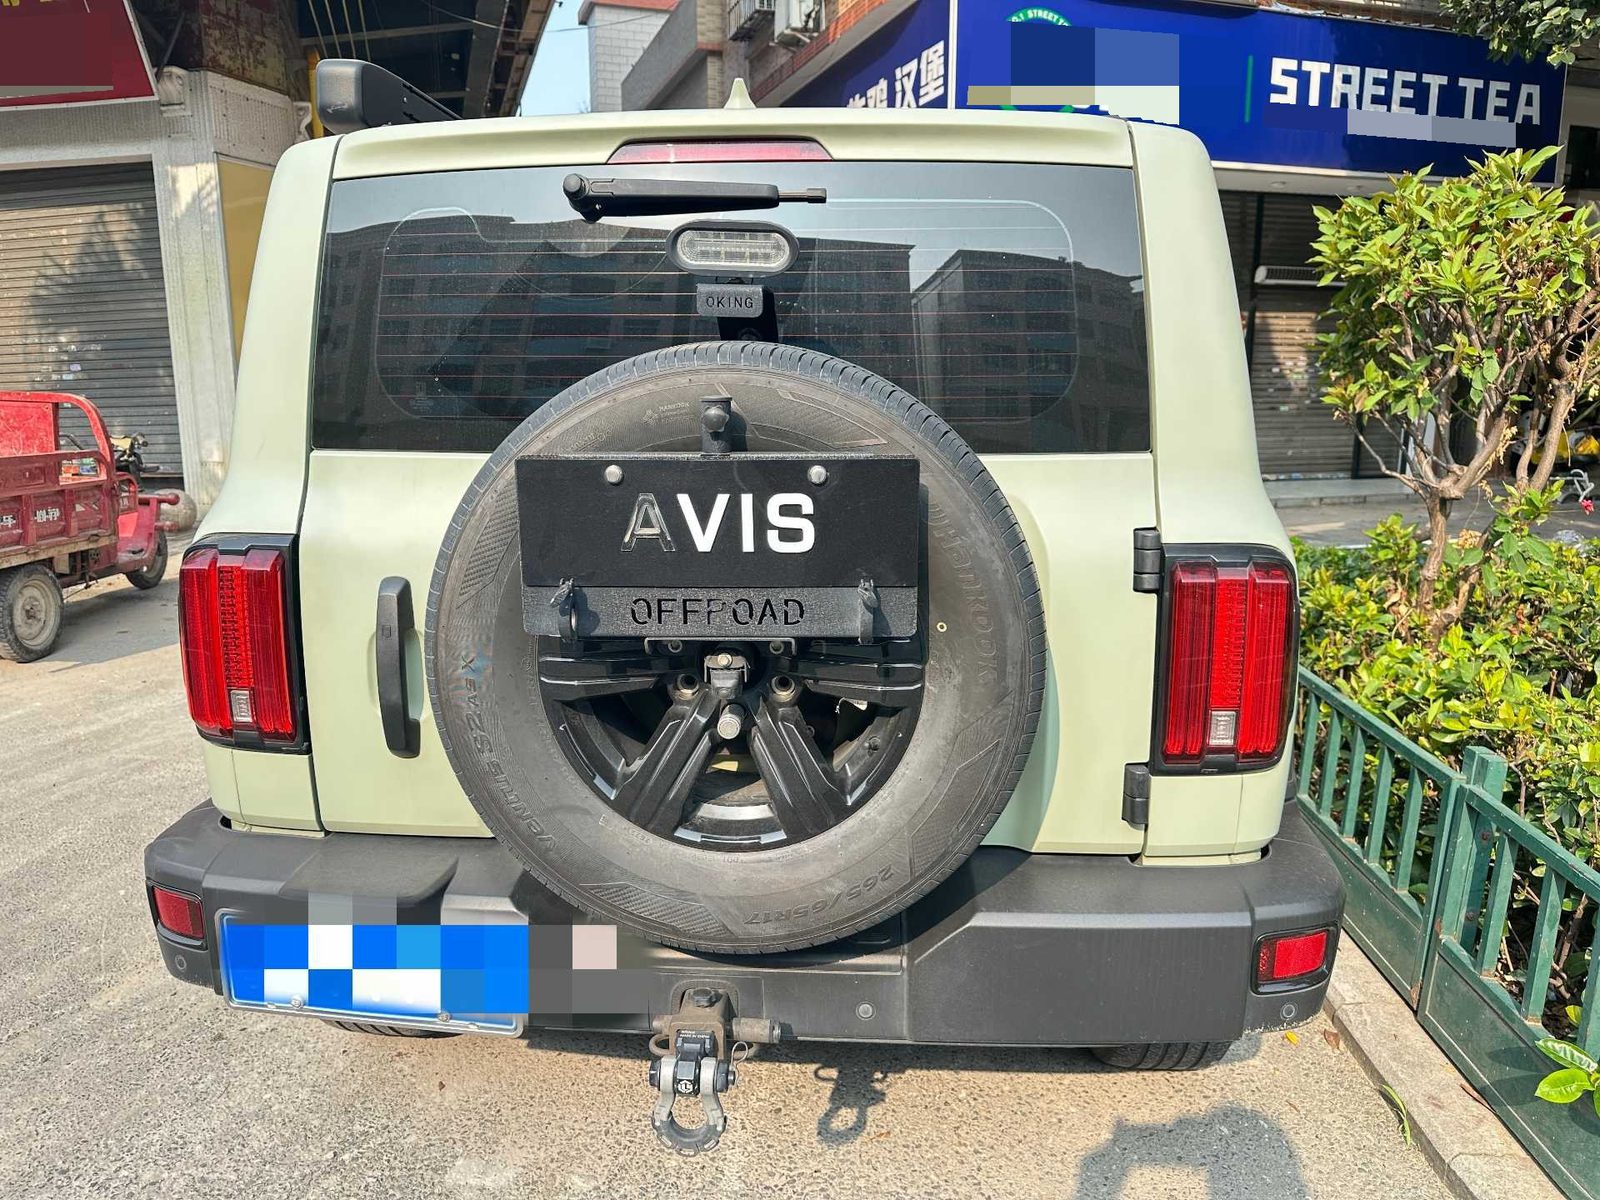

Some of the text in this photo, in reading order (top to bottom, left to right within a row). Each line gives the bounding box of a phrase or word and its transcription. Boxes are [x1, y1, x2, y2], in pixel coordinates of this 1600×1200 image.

[1027, 9, 1058, 22] STREET
[1269, 57, 1541, 125] STREET TEA
[706, 296, 754, 309] OKING
[620, 492, 816, 554] AVIS
[744, 864, 894, 925] 265/65R17
